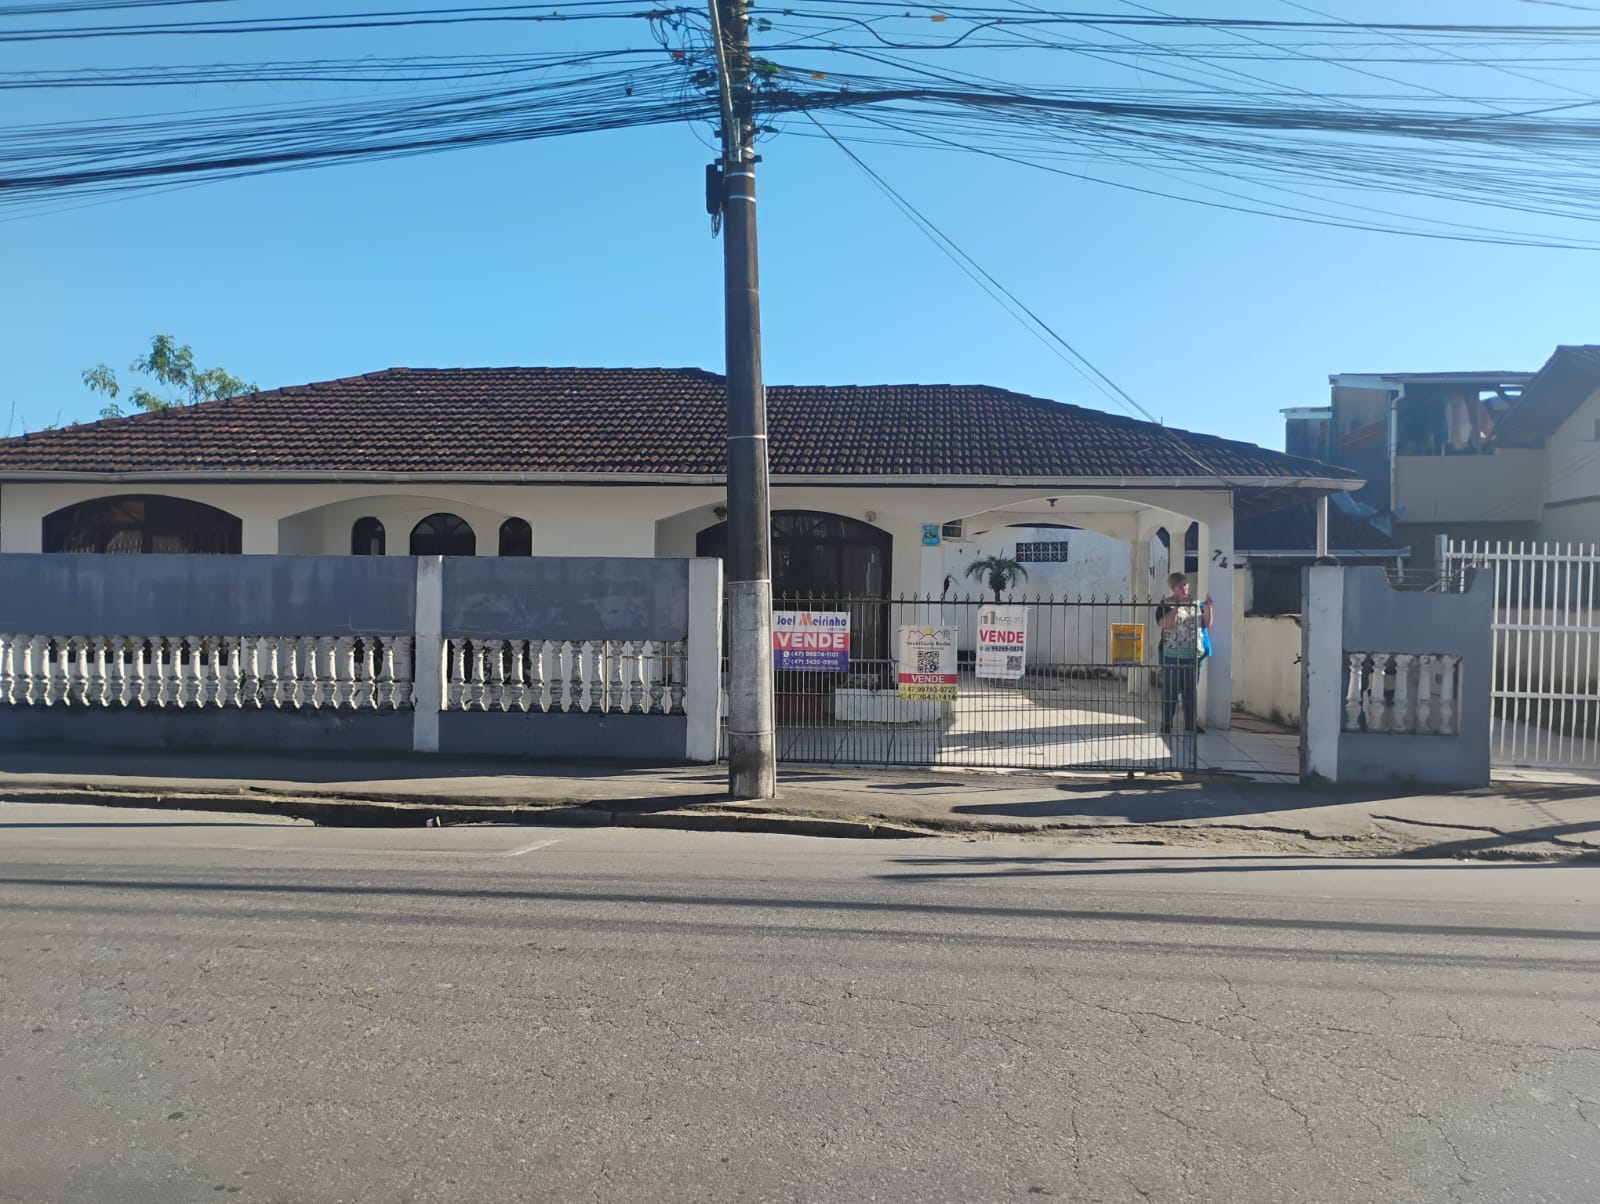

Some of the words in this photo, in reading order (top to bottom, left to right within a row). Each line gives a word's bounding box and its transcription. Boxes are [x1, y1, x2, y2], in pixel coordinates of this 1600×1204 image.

[1212, 549, 1228, 569] 74
[777, 615, 796, 626] Joel
[799, 612, 847, 627] Meirinho
[776, 632, 845, 649] VENDE
[979, 630, 1024, 644] VENDE
[911, 674, 945, 683] VENDE
